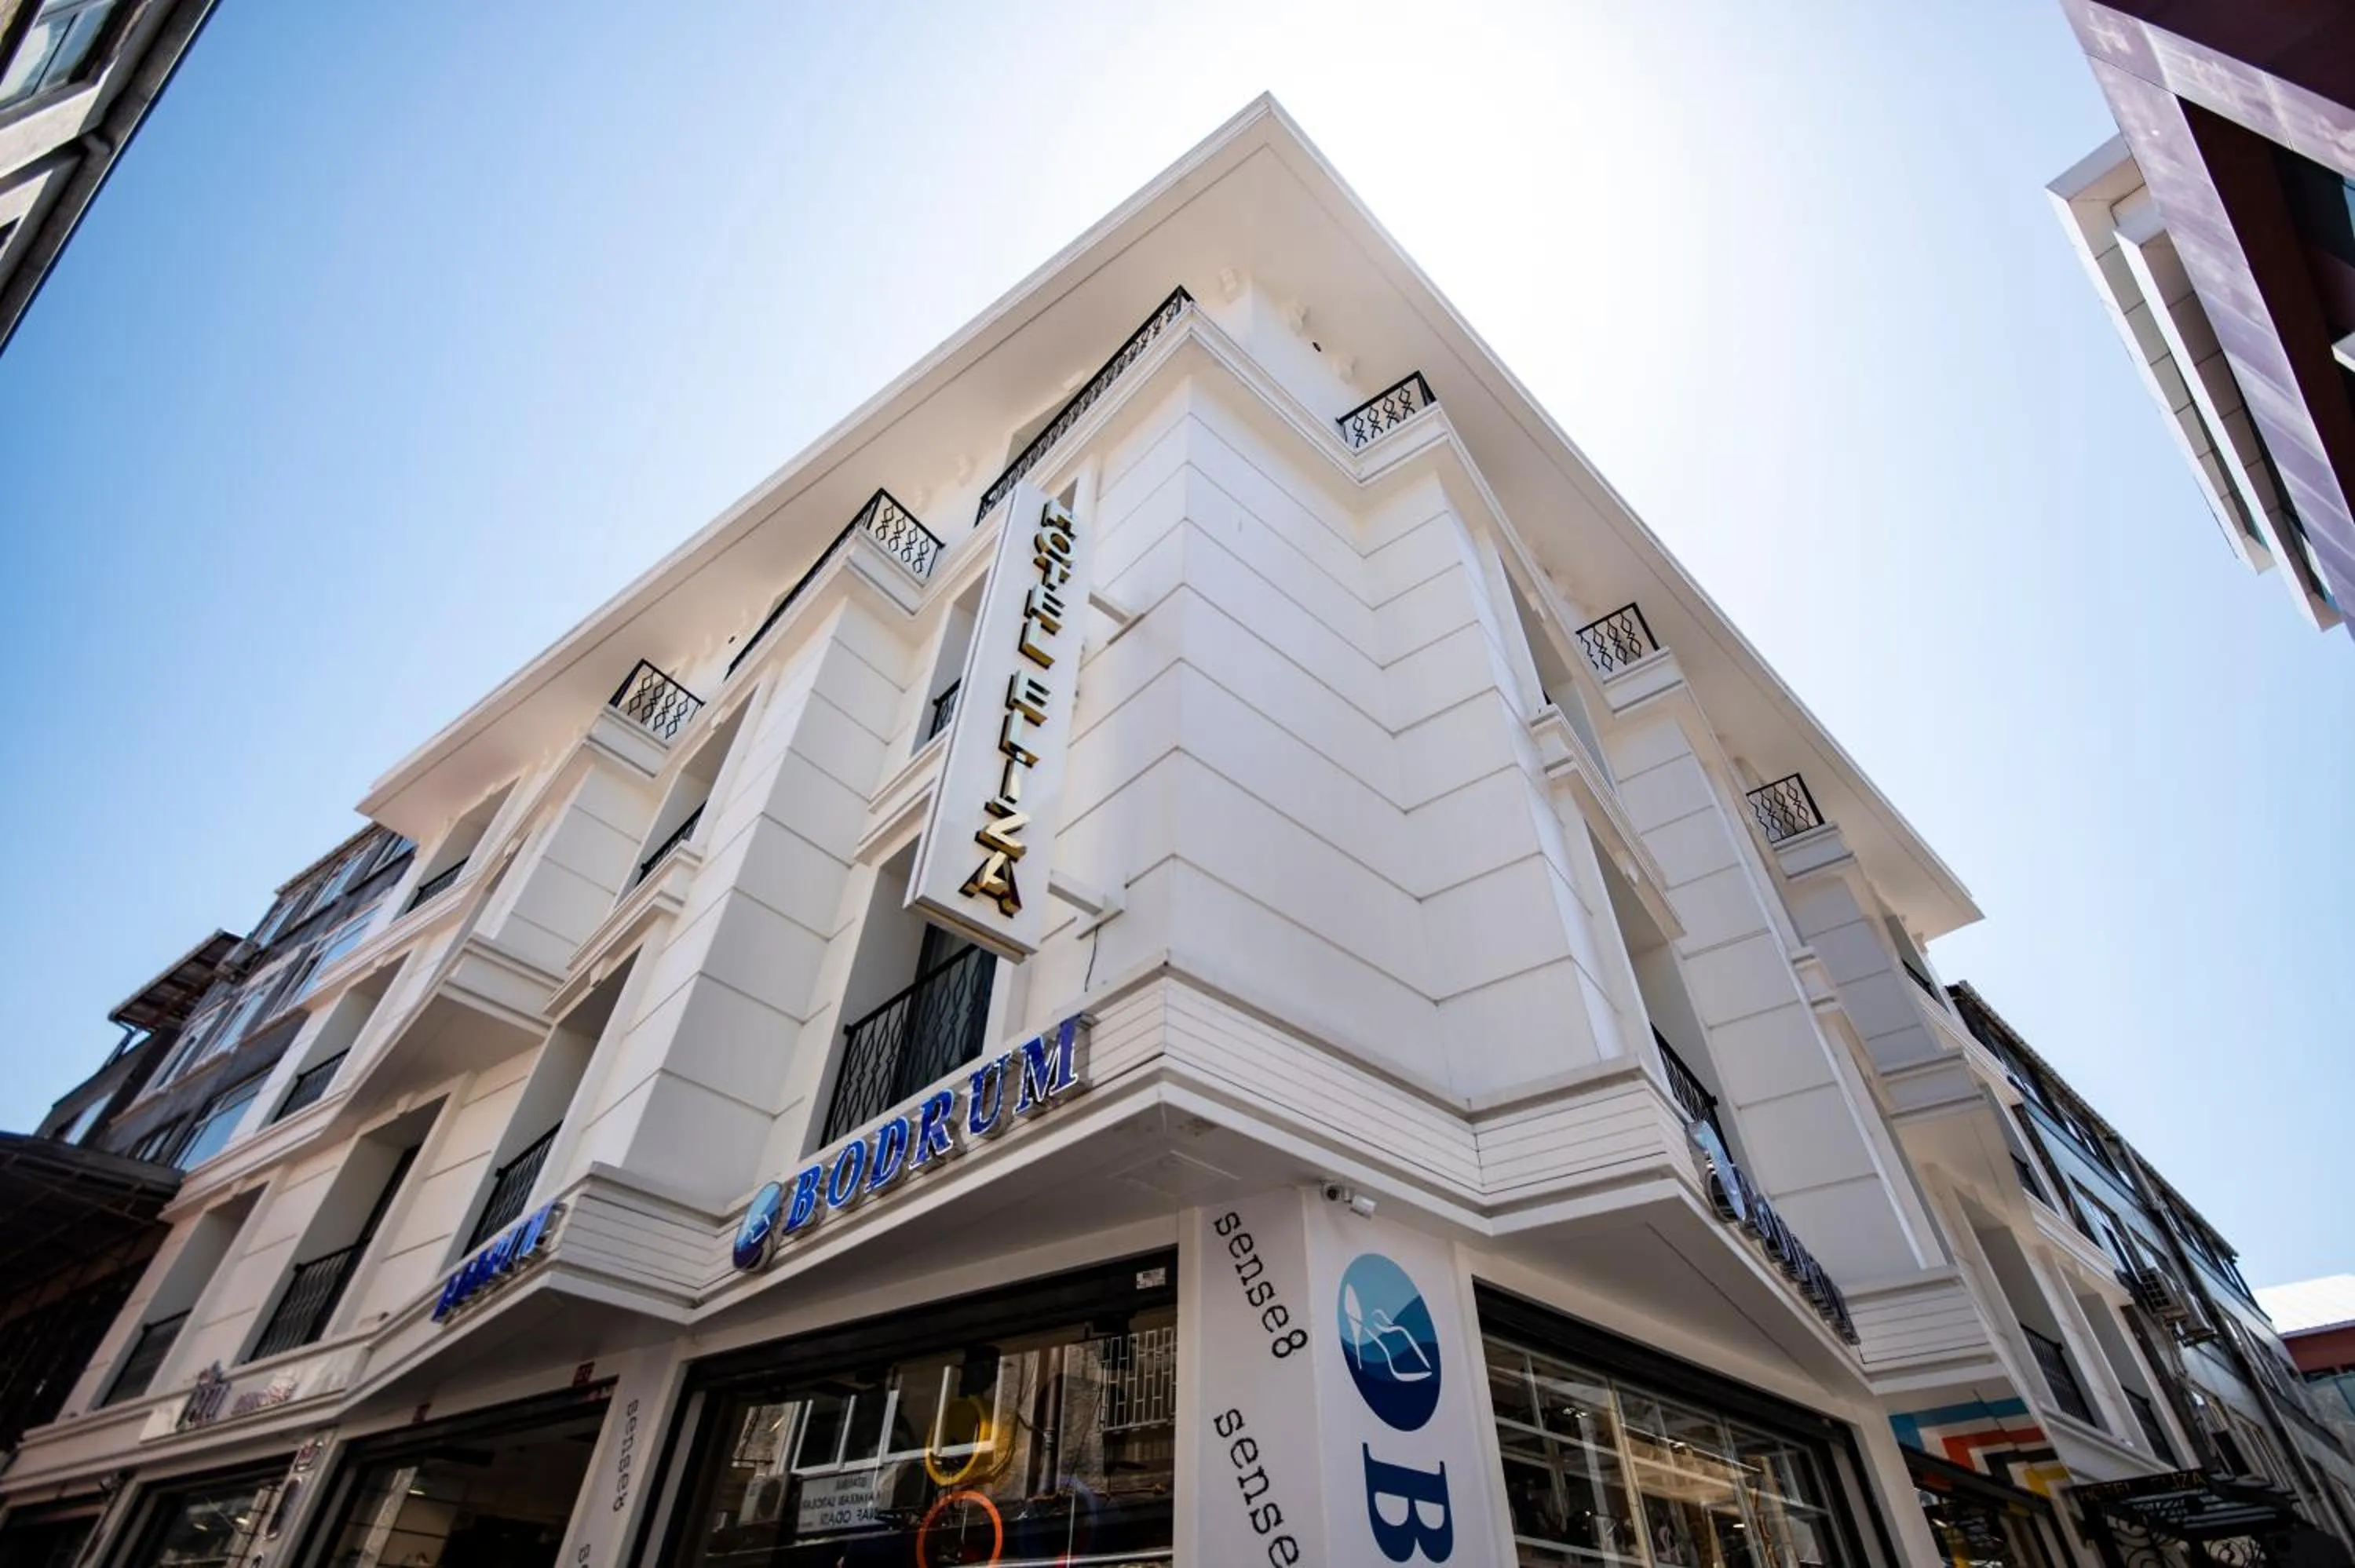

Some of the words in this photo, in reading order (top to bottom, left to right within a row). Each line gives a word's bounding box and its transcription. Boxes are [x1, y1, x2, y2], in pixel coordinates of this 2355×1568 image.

[1019, 498, 1077, 669] HOTEL
[958, 669, 1051, 918] ELIZA
[783, 1012, 1083, 1236] BODRUM
[1213, 1211, 1309, 1359] sense8
[1362, 1442, 1454, 1563] B
